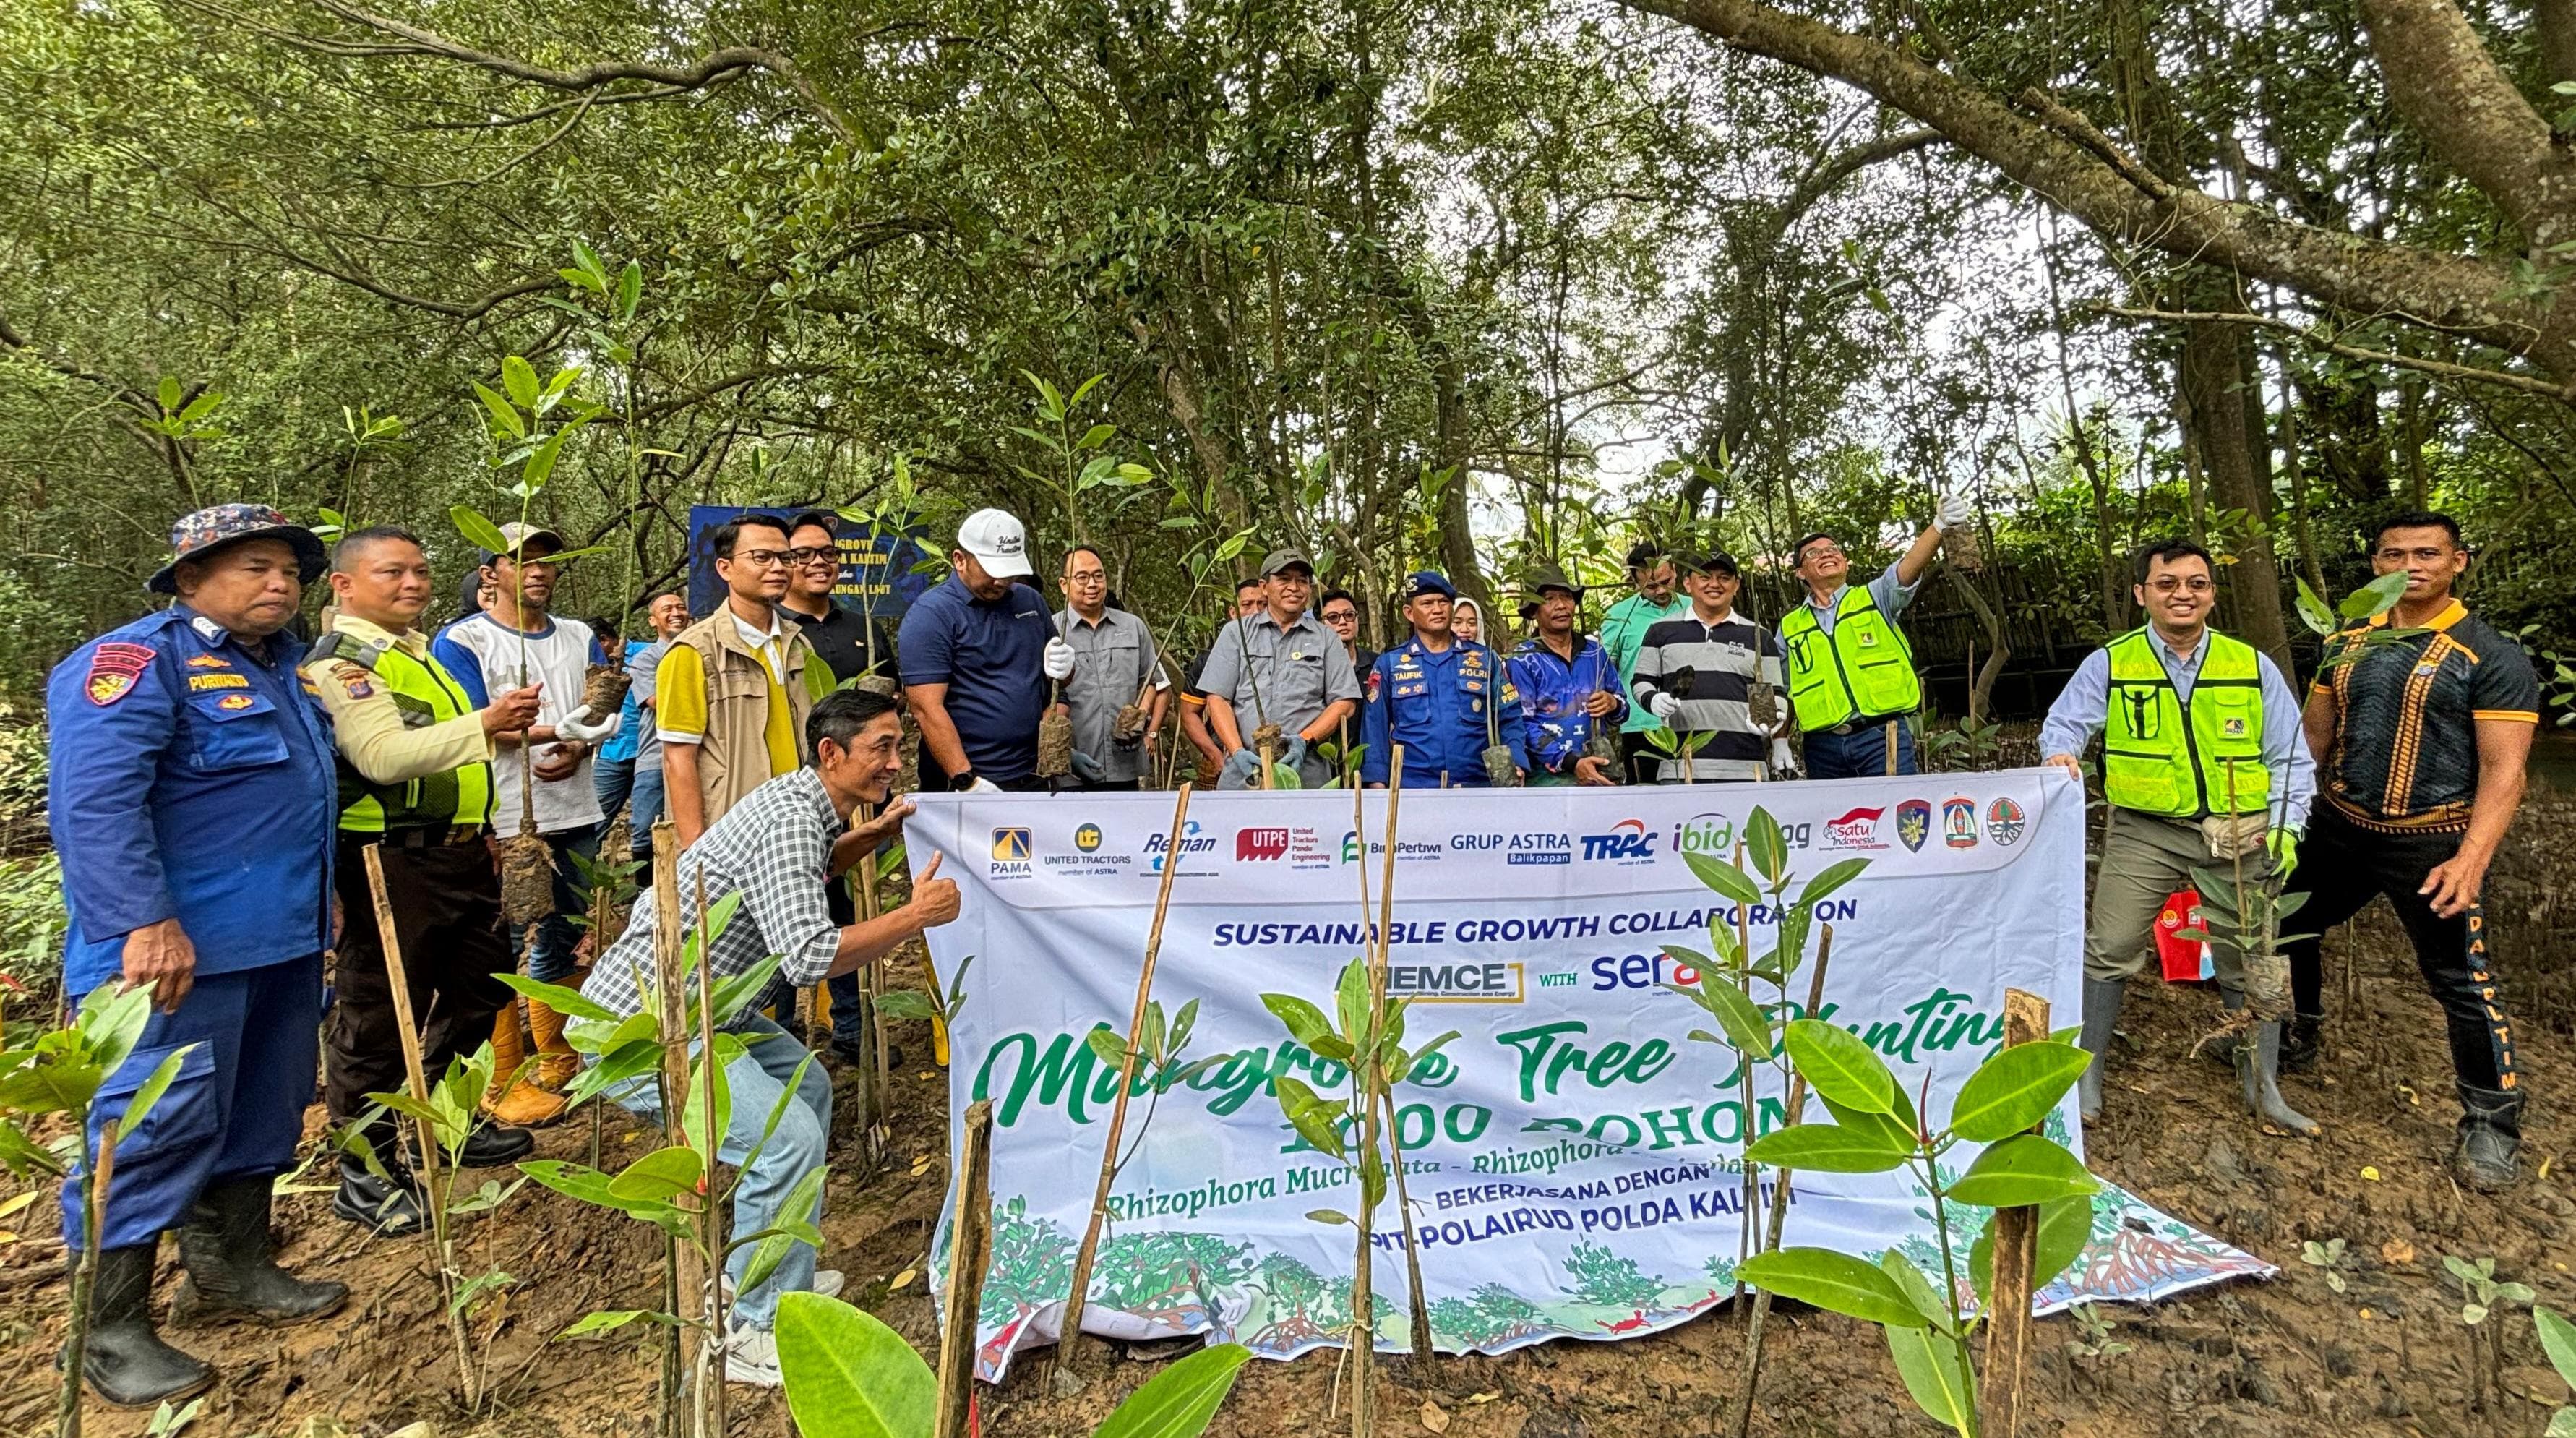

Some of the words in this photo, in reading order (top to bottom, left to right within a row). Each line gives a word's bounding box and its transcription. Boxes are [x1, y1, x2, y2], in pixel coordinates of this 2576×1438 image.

[1394, 671, 1423, 681] TAUFIK
[1459, 668, 1487, 678] POLRI
[1672, 821, 1733, 852] ibid
[1837, 823, 1870, 837] satu
[1253, 831, 1286, 848] UTPE
[1451, 834, 1503, 849] GRUP
[1508, 833, 1571, 849] ASTRA
[1580, 832, 1659, 860] TRAC
[1833, 836, 1876, 846] Indonesia
[1044, 855, 1078, 865] UNITED
[1081, 855, 1131, 865] TRACTORS
[1292, 853, 1331, 863] Engineering
[1510, 853, 1568, 865] Balikpapan
[991, 863, 1032, 874] PAMA
[1214, 920, 1446, 946] SUSTAINABLE
[1455, 914, 1600, 943] GROWTH
[1540, 972, 1579, 988] WITH
[1496, 1020, 1676, 1103] Tree
[1614, 1163, 1710, 1195] DENGAN
[1107, 1176, 1276, 1221] Rhizophora
[1581, 1197, 1685, 1233] POLDA
